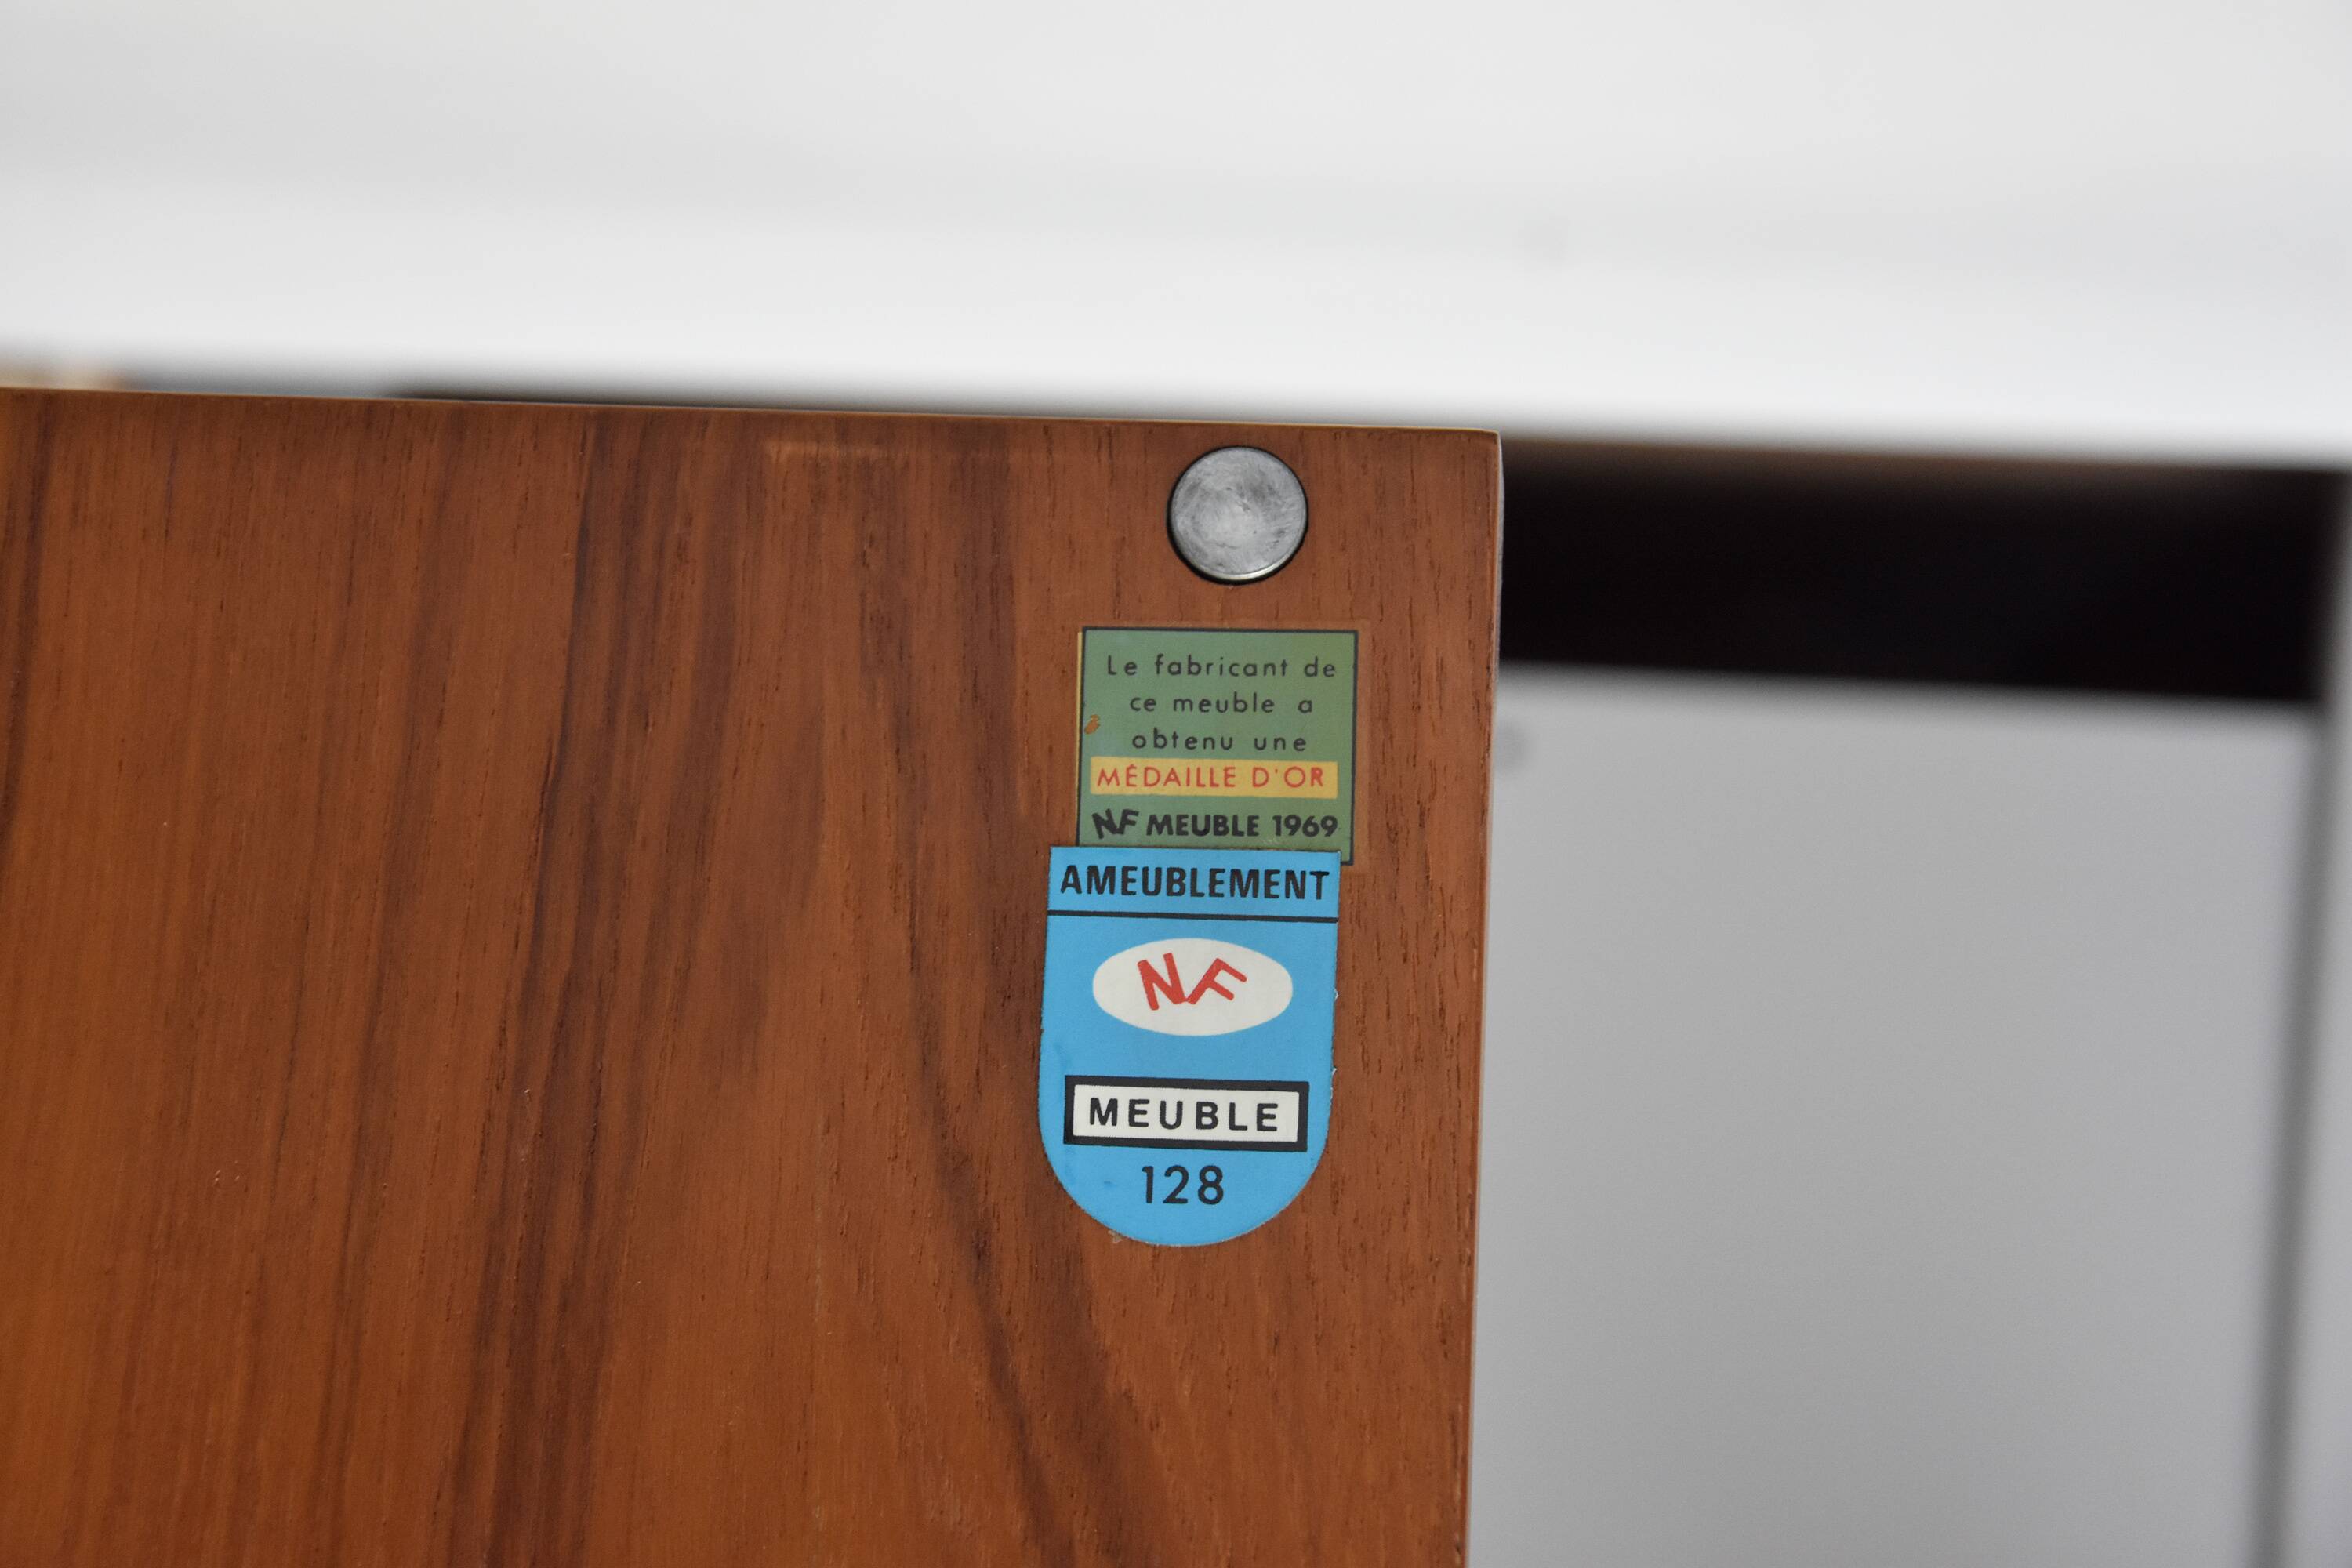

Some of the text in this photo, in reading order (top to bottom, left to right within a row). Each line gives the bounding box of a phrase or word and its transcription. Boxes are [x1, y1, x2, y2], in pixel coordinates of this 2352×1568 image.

[1107, 653, 1336, 677] Le fabricant de
[1130, 691, 1312, 713] ce meuble a
[1131, 728, 1307, 752] obtenu une
[1098, 764, 1324, 788] MÉDAILLE D'OR
[1091, 808, 1338, 839] NF MEUBLE 1969
[1060, 864, 1330, 900] AMEUBLEMENT
[1138, 952, 1247, 1011] NF
[1089, 1098, 1278, 1131] MEUBLE
[1142, 1165, 1225, 1205] 128
